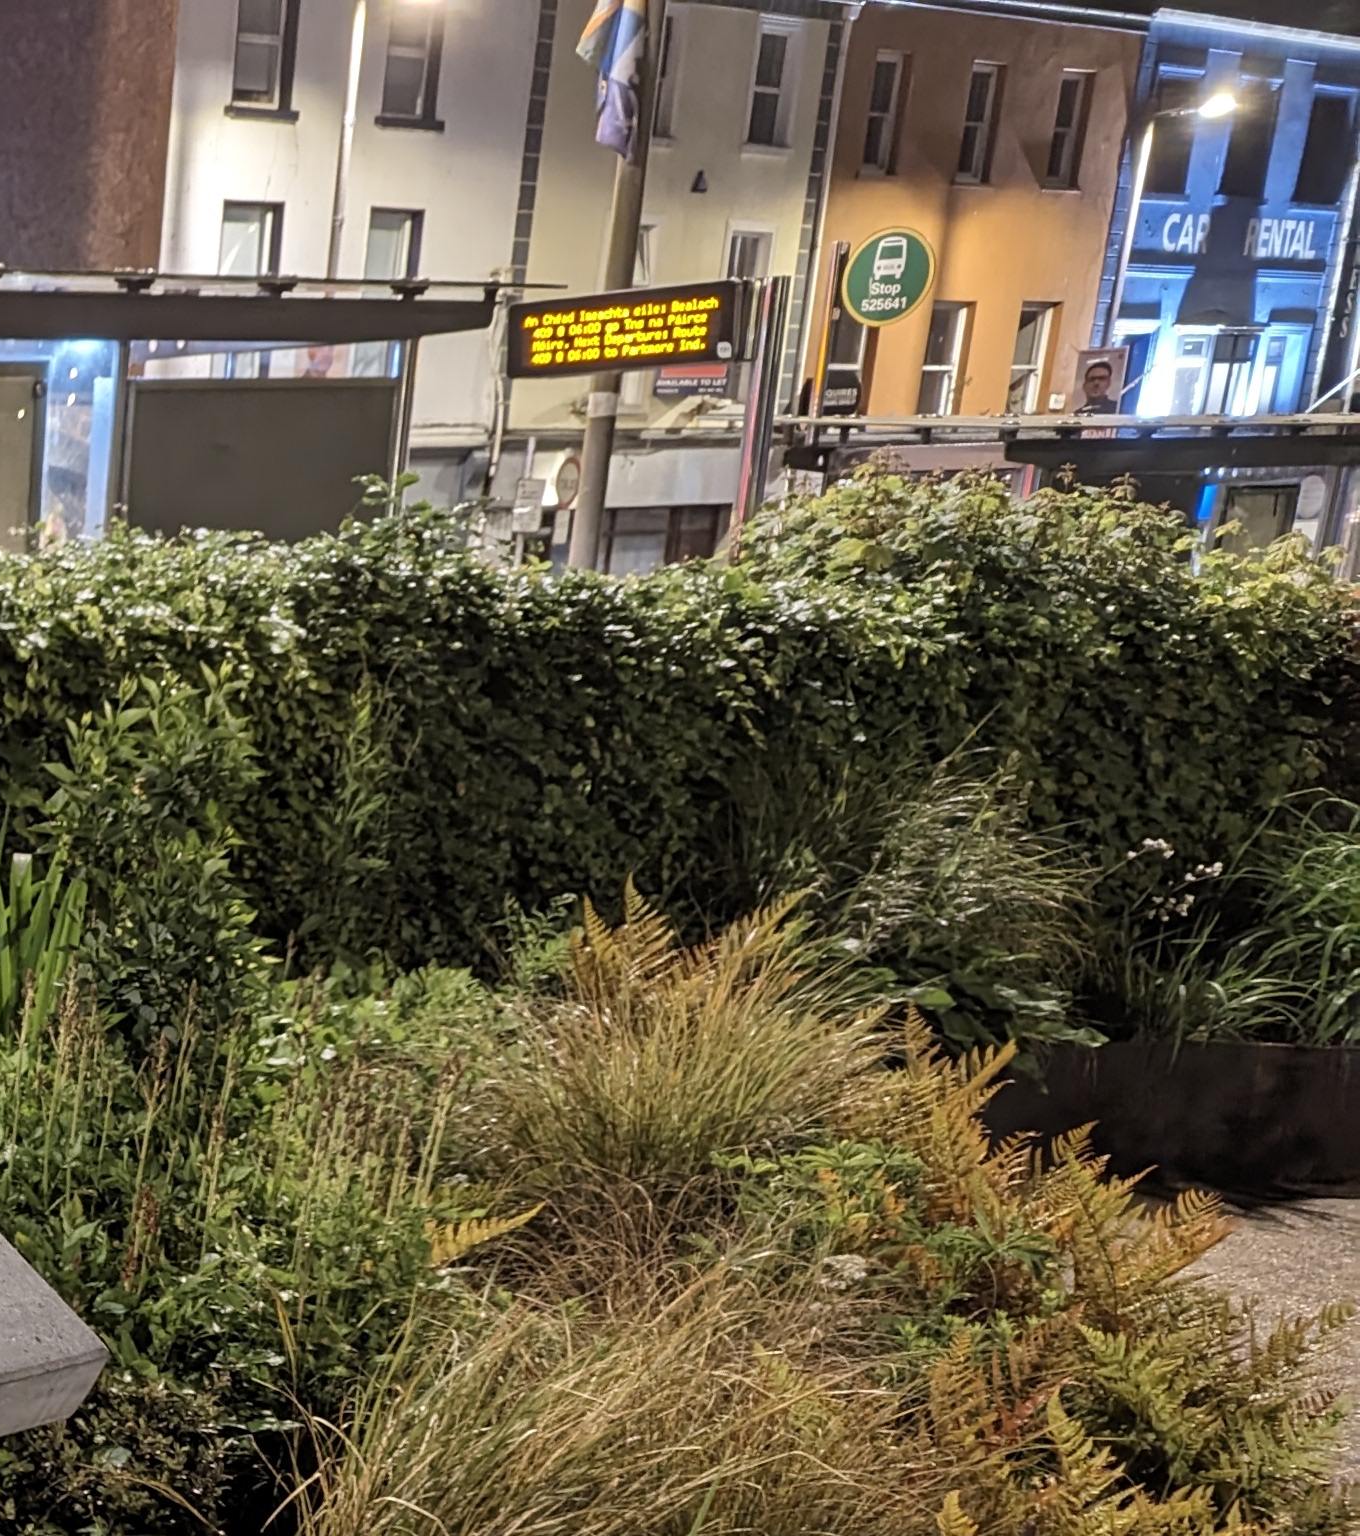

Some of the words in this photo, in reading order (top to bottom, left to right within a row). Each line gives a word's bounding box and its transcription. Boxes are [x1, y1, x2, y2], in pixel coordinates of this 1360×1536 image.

[1162, 213, 1211, 254] CAR
[1243, 217, 1316, 259] RENTAL
[870, 282, 901, 296] Stop
[524, 316, 538, 328] An
[671, 297, 719, 312] Bealach
[861, 296, 907, 312] 525641
[533, 326, 553, 339] 409
[568, 323, 601, 336] 06:00
[648, 316, 663, 327] na
[574, 336, 600, 348] Next
[673, 325, 707, 338] Route
[531, 352, 552, 364] 409
[567, 348, 600, 362] 06:00
[604, 347, 618, 358] to
[679, 338, 706, 351] Ind.
[712, 378, 727, 386] LET
